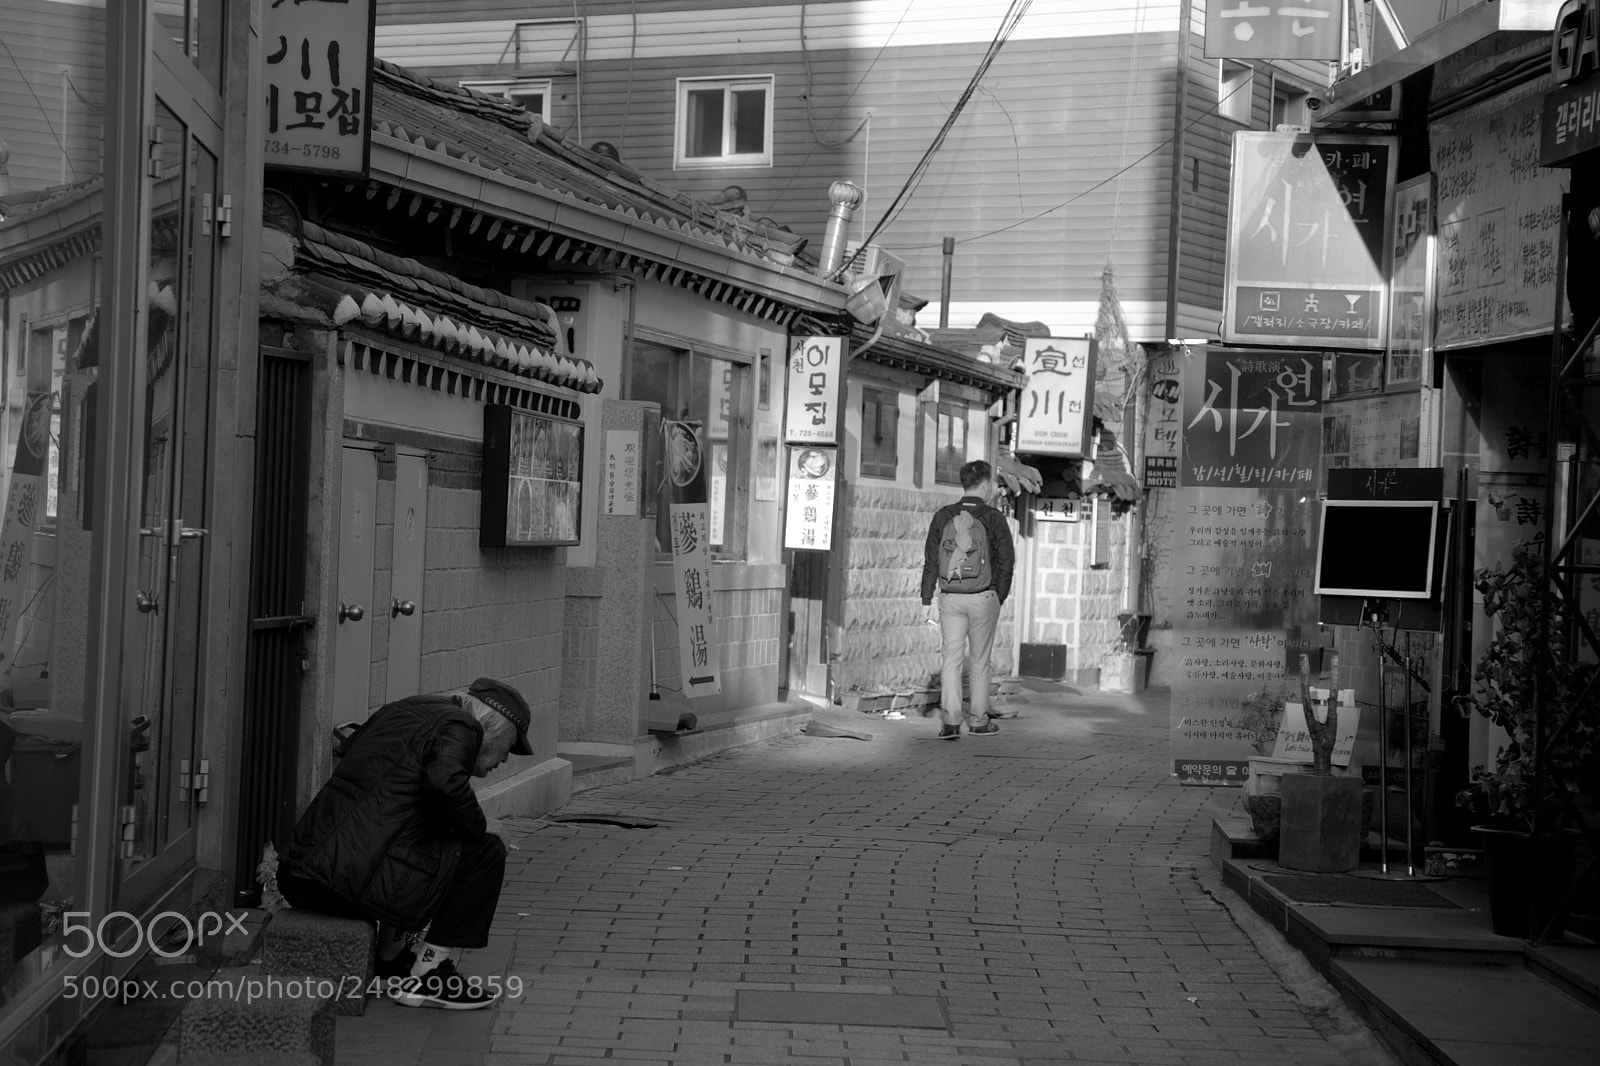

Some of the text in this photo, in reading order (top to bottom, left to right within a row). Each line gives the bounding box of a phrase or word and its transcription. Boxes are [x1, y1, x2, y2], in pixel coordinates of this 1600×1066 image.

[1556, 91, 1600, 145] 갤러리
[264, 139, 341, 160] 734-5798
[792, 340, 805, 374] 사천
[804, 345, 830, 426] 이모집
[1028, 345, 1072, 425] 宣川
[1187, 357, 1319, 461] 시가연
[1187, 505, 1198, 515] 그
[1201, 504, 1223, 516] 곳에
[1226, 505, 1247, 517] 가면
[1188, 539, 1212, 548] 그리고
[1185, 565, 1196, 575] 그
[1199, 565, 1220, 576] 곳에
[1181, 637, 1192, 646] 그
[1195, 636, 1216, 648] 곳에
[1219, 637, 1241, 649] 가면
[1181, 763, 1222, 776] 예약문의
